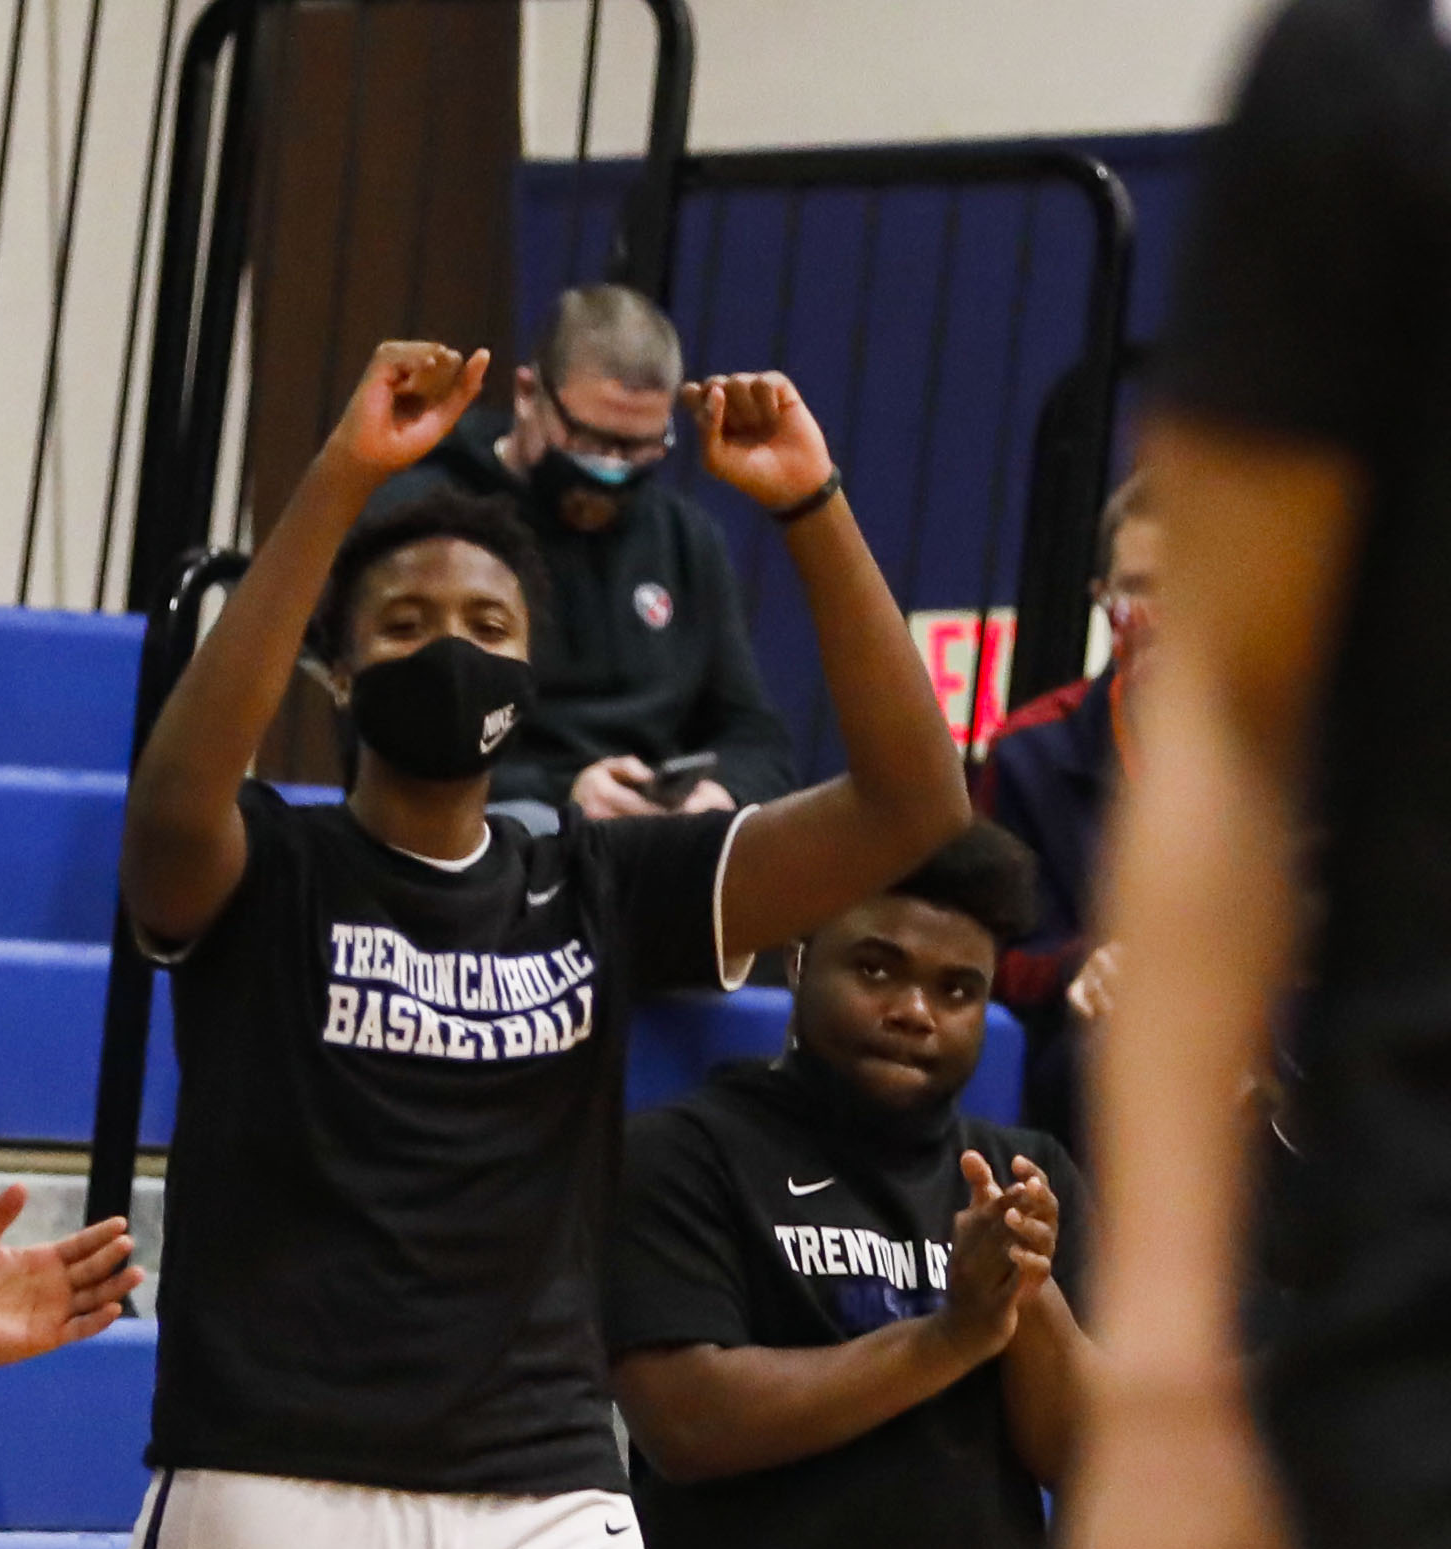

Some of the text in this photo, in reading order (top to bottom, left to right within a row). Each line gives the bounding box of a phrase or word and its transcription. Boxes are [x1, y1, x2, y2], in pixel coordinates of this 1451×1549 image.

[331, 922, 595, 1012] TRENTON CATHOLIC
[322, 984, 594, 1061] BASKETBALL
[774, 1225, 917, 1290] TRENTON
